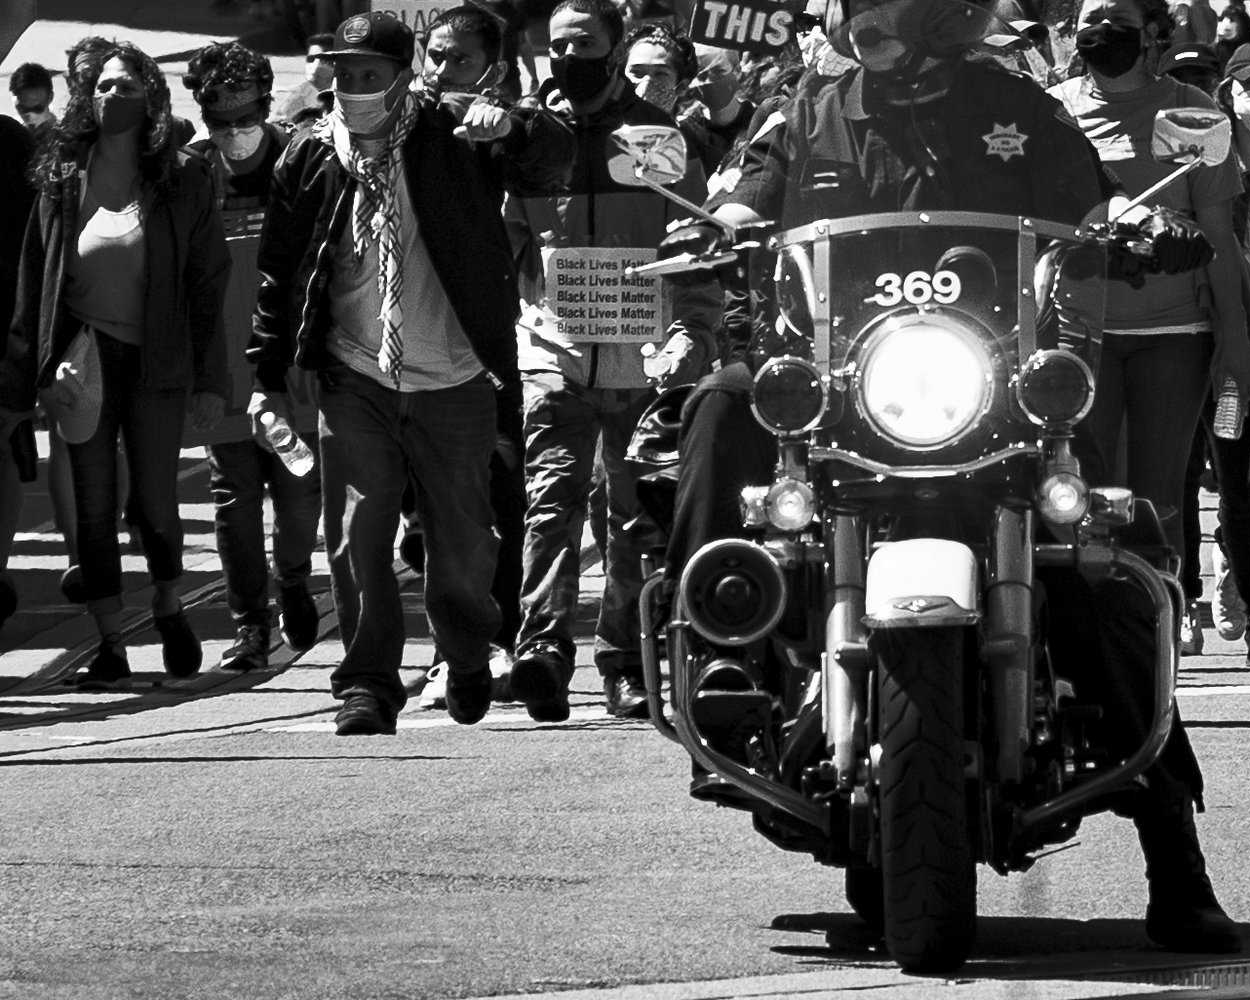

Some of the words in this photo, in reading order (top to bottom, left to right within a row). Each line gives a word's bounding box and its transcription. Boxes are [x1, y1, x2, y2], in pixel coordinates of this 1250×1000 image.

[703, 0, 794, 47] THIS
[556, 258, 586, 270] Black
[589, 259, 618, 271] Lives
[557, 274, 586, 287] Black
[589, 275, 619, 287] Lives
[621, 275, 656, 288] Matter
[875, 270, 962, 307] 369
[557, 290, 586, 303] Black
[588, 291, 619, 303] Lives
[621, 291, 656, 304] Matter
[557, 307, 586, 319] Black
[588, 307, 618, 320] Lives
[621, 308, 656, 320] Matter
[557, 322, 586, 336] Black
[588, 323, 618, 336] Lives
[621, 324, 656, 336] Matter
